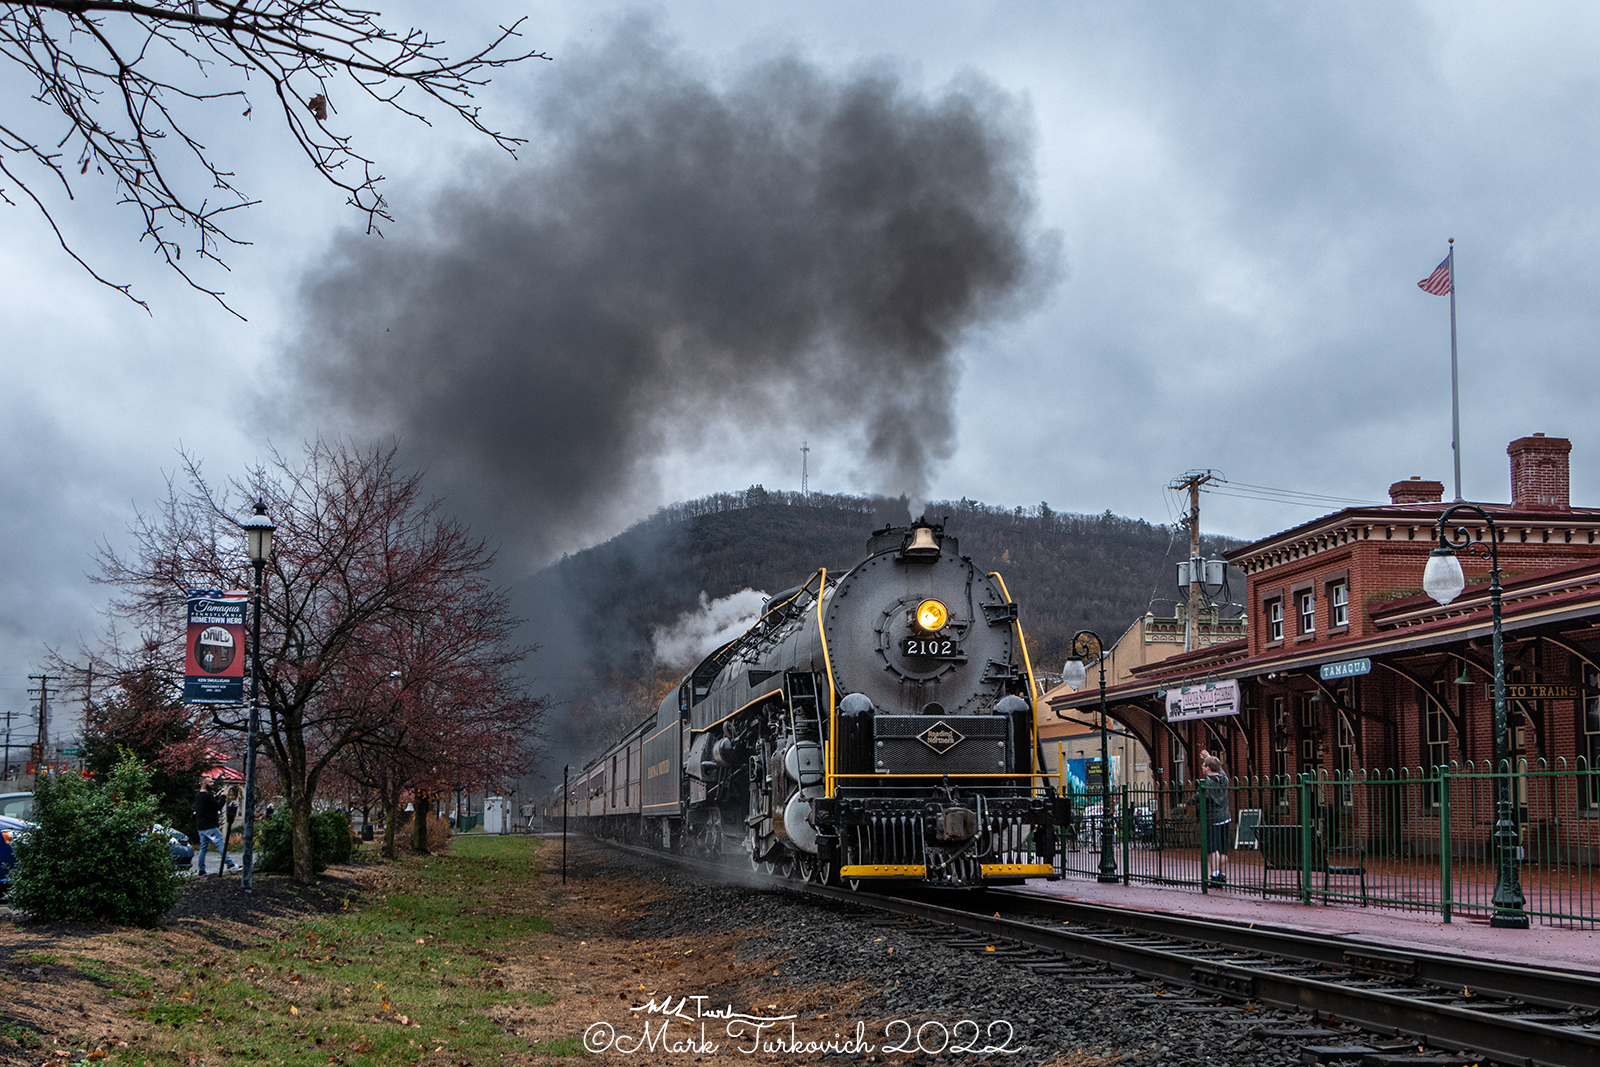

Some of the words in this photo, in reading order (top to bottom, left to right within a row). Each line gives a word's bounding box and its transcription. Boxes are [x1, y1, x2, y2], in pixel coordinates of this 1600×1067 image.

[194, 600, 240, 616] Tamaqua
[226, 617, 243, 625] HERO
[907, 640, 952, 655] 2102
[1323, 661, 1367, 677] TAMAQUA
[1509, 686, 1526, 697] TO
[1530, 686, 1578, 697] TRAINS
[927, 730, 953, 739] Reading
[927, 736, 955, 744] Northern
